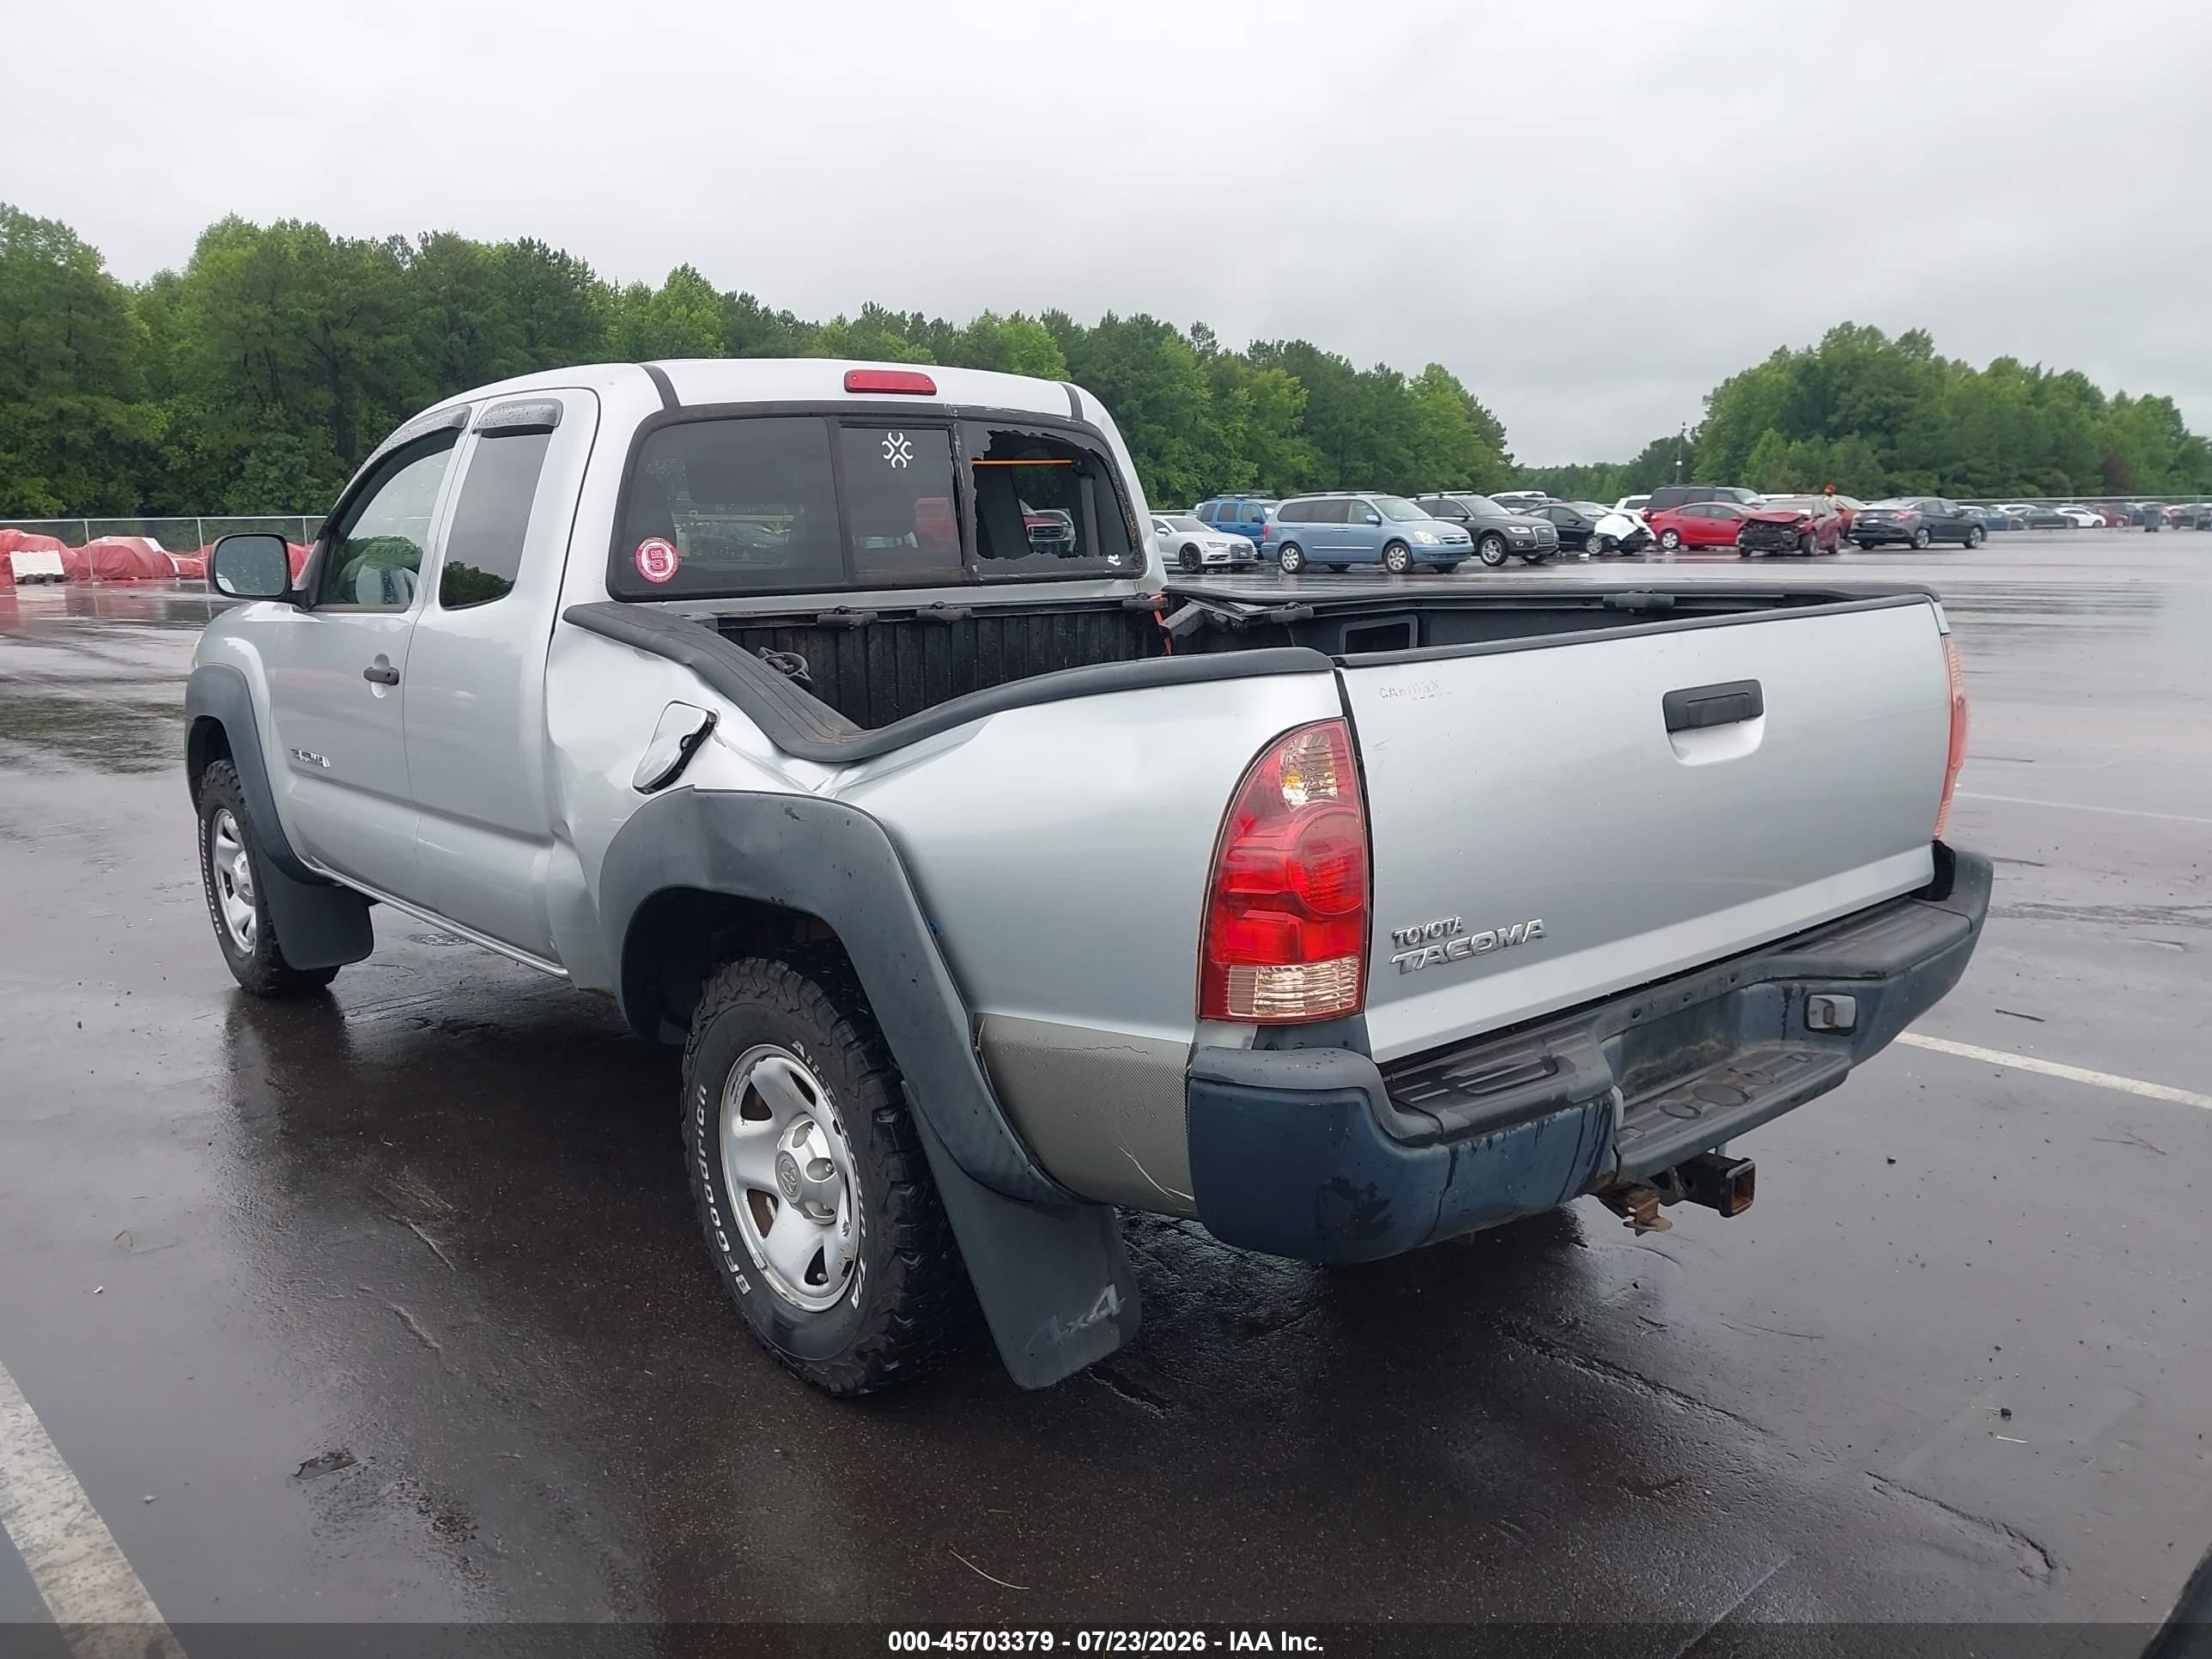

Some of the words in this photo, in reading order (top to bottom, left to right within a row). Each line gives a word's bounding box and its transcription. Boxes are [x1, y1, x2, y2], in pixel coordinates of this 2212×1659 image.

[1389, 918, 1547, 975] TACOMA
[1391, 915, 1463, 948] TOYOTA
[696, 1085, 752, 1295] BFGoodrich
